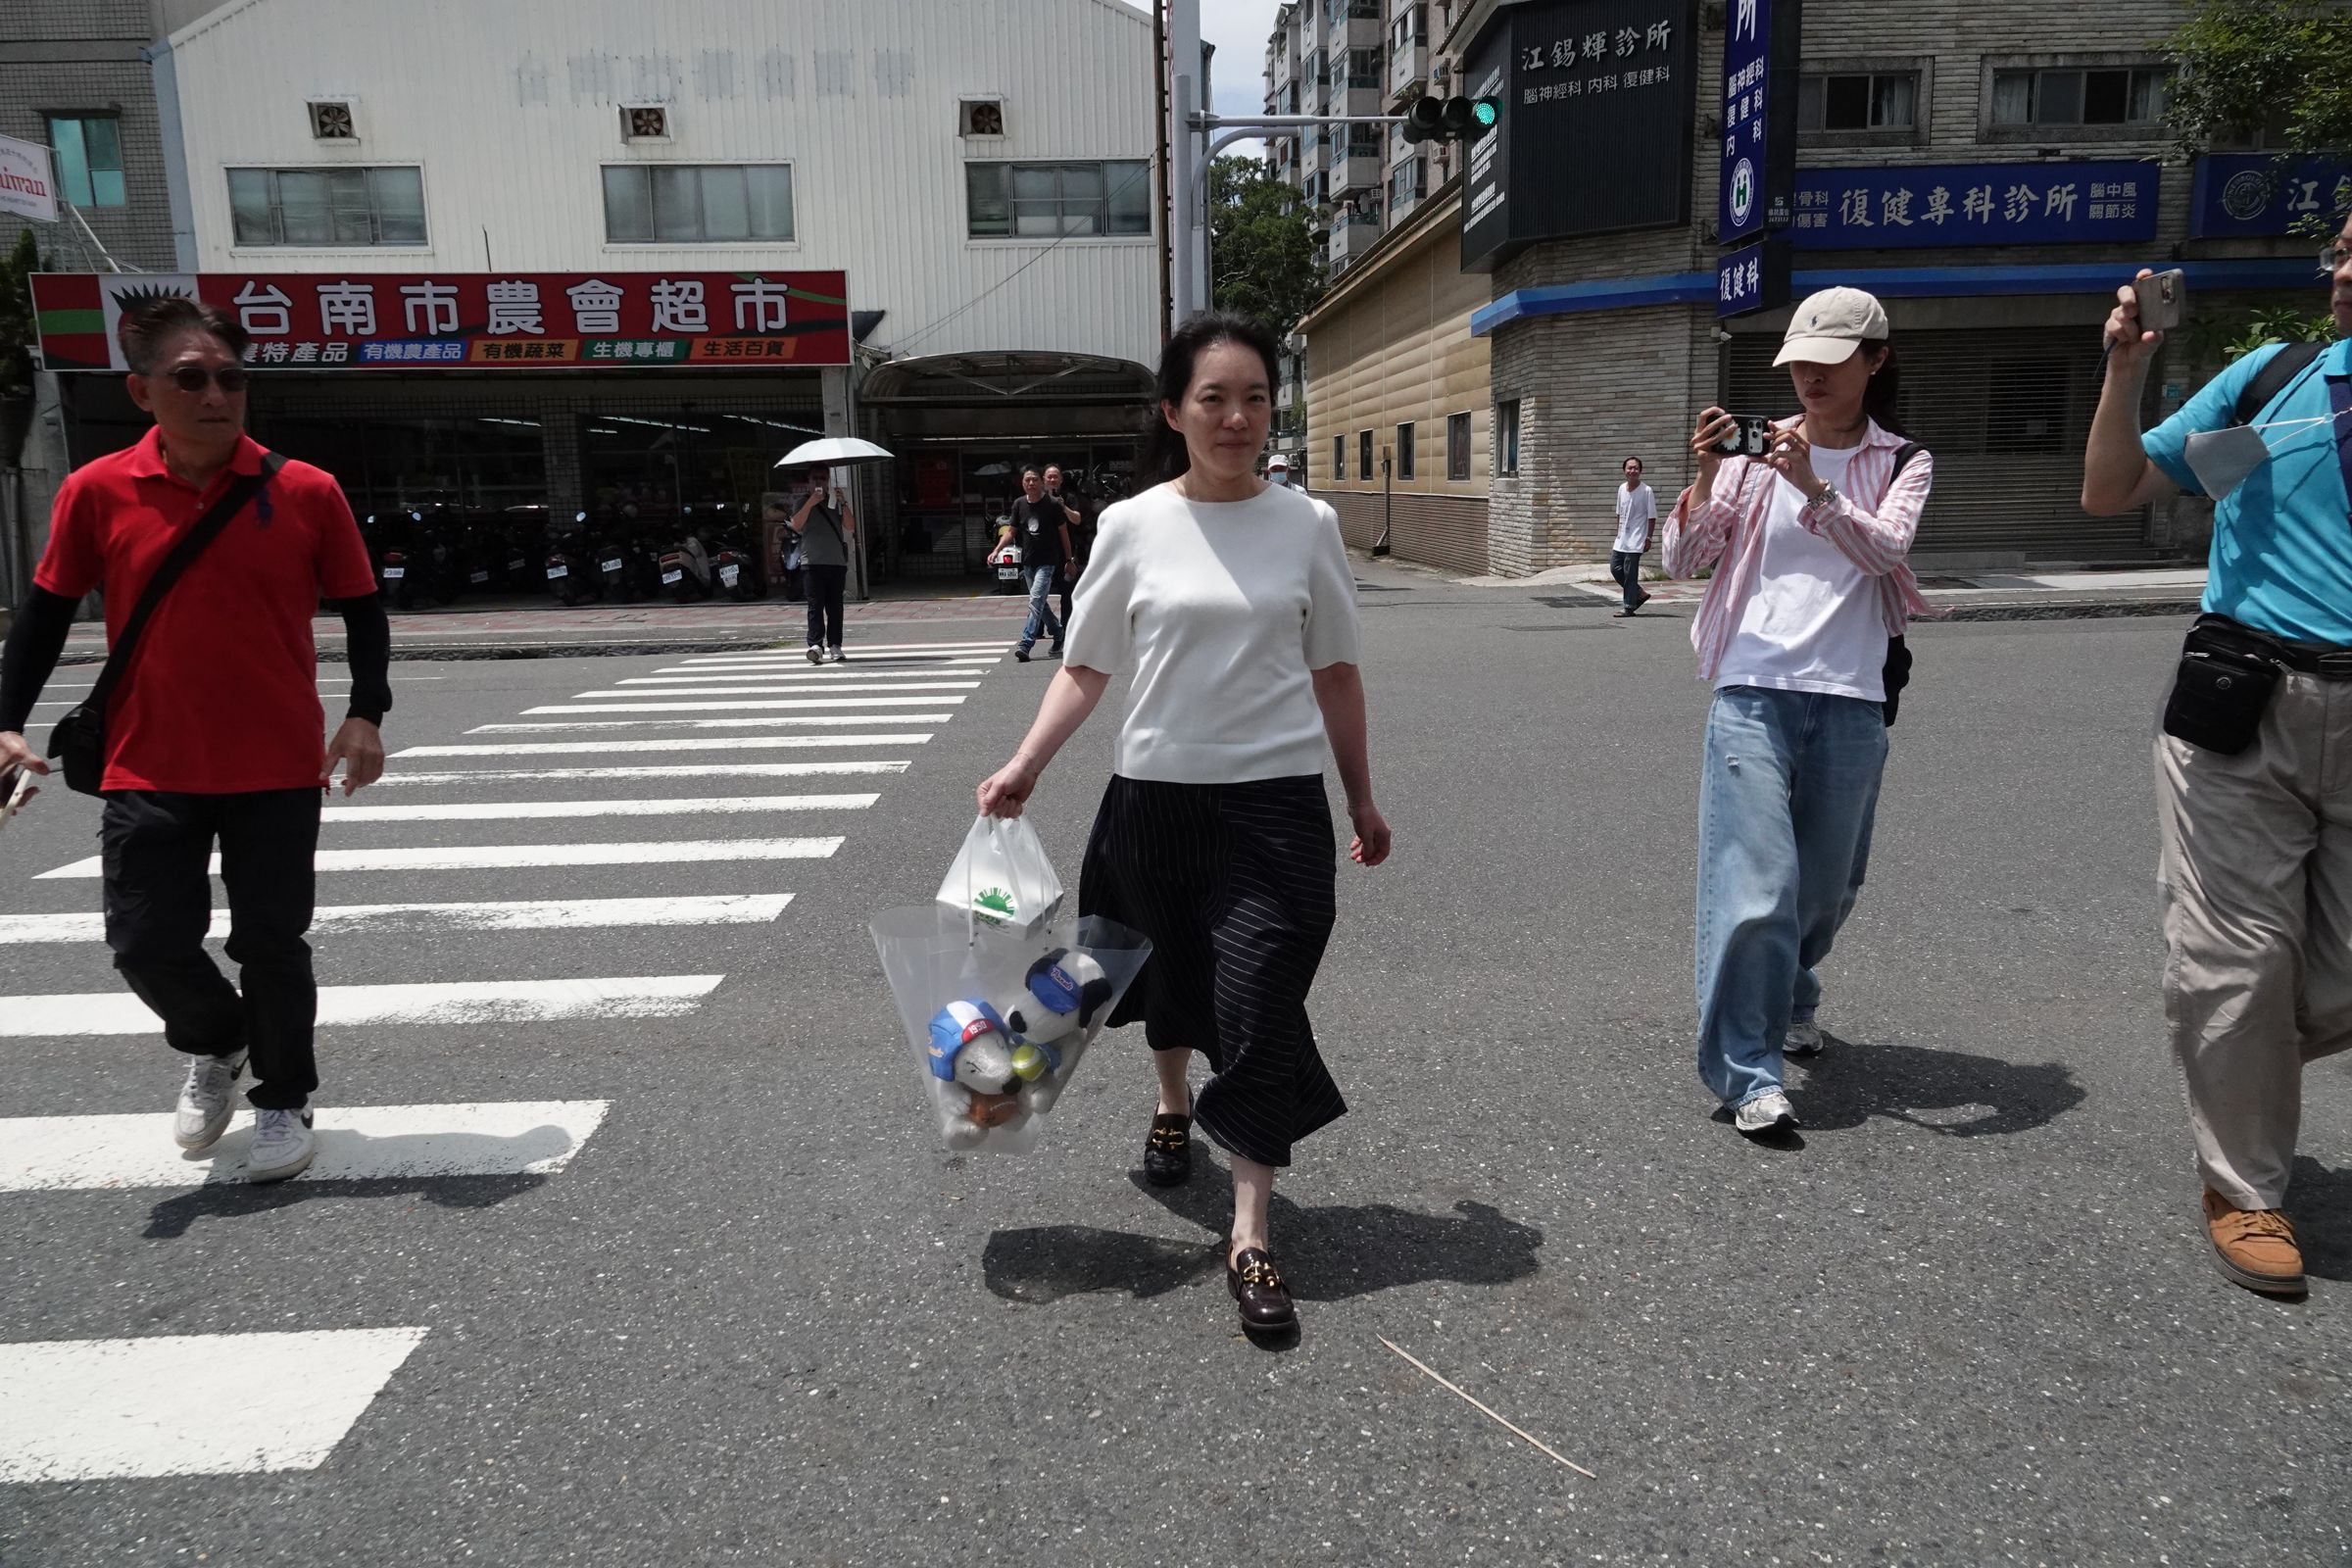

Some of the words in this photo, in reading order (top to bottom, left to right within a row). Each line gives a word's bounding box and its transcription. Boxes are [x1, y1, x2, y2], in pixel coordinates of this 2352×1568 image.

[1521, 20, 1672, 72] 江錫輝診所
[1524, 79, 1582, 105] 腦神經科
[1623, 65, 1670, 88] 復健科
[0, 166, 47, 197] iwan
[2090, 181, 2137, 198] 腦中風
[2286, 174, 2352, 212] 江
[1793, 190, 1829, 207] 骨科
[1838, 182, 2079, 228] 復健專科診所
[2088, 204, 2136, 220] 關節炎
[1792, 213, 1828, 227] 傷害
[1720, 257, 1759, 302] 復健科
[232, 277, 788, 336] 台南市農會超市
[364, 343, 462, 360] 有機農產品
[483, 342, 565, 360] 有機蔬菜
[592, 340, 676, 359] 生機專櫃
[703, 338, 785, 357] 生活百貨
[968, 1020, 988, 1036] 1950
